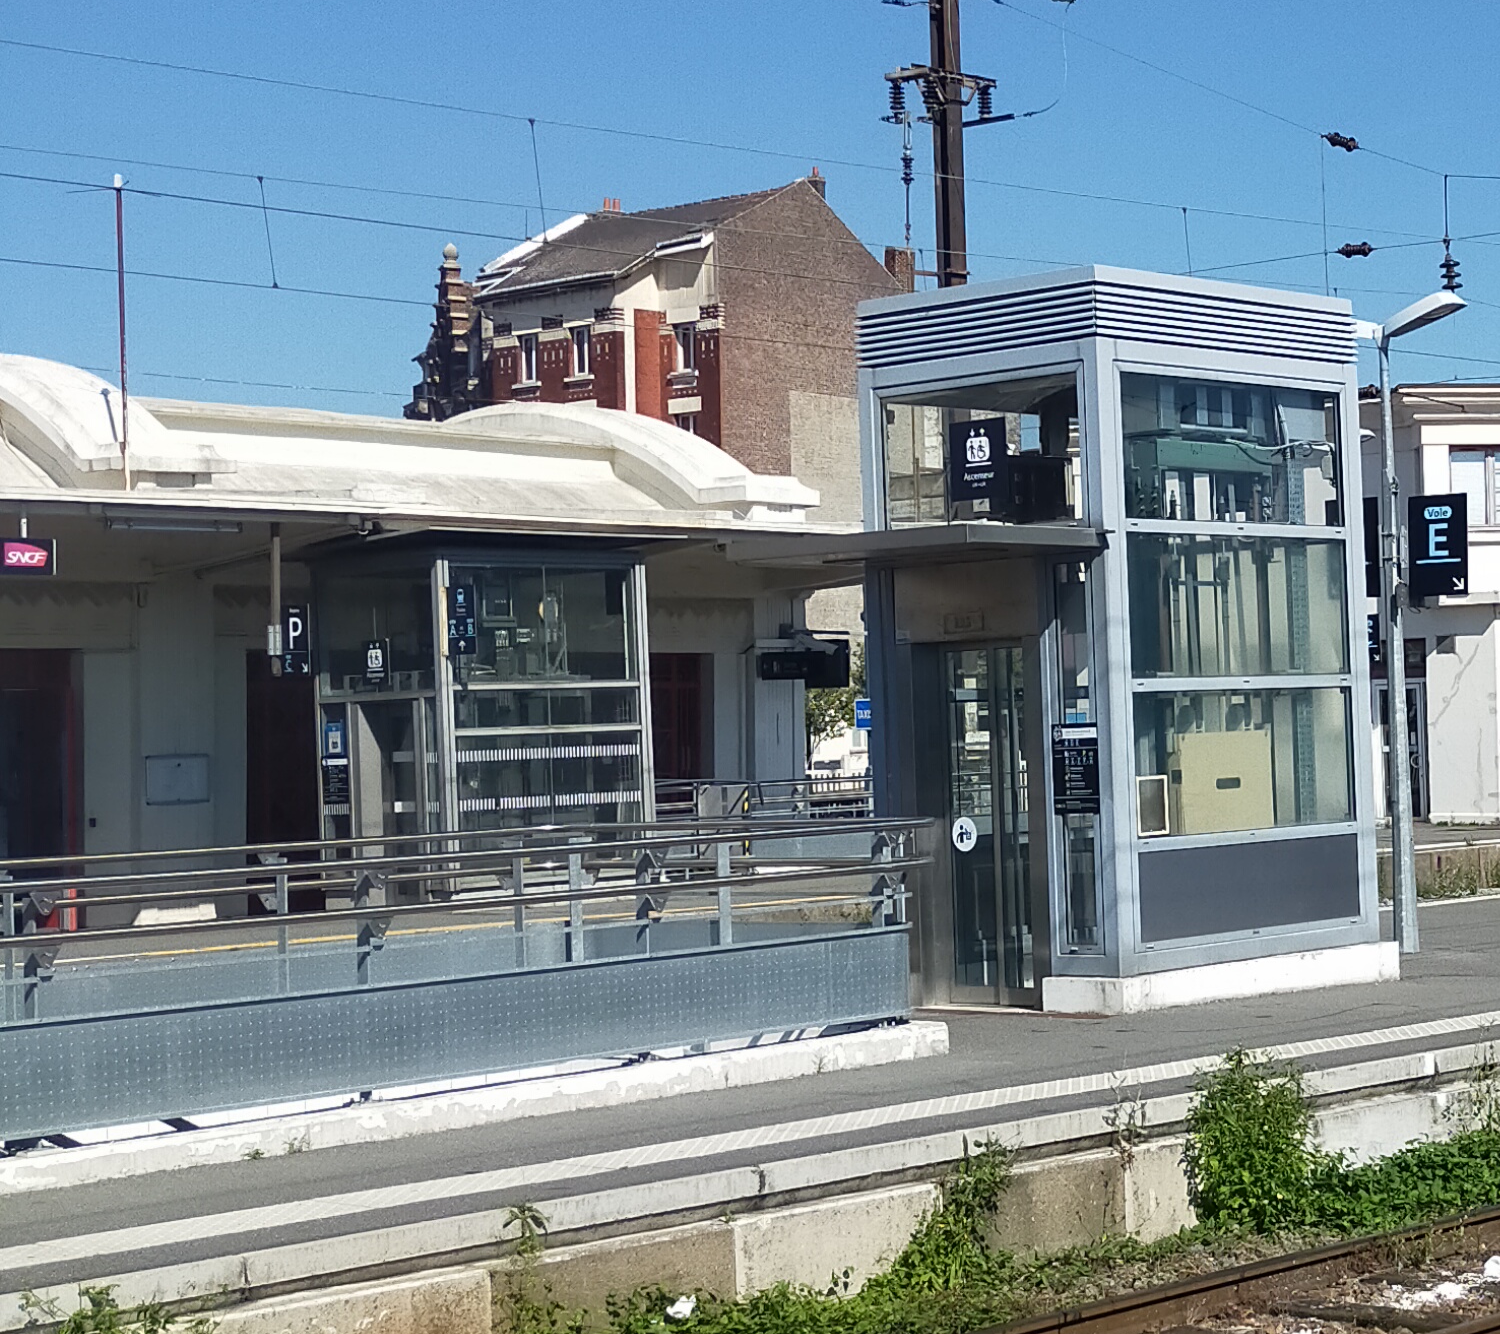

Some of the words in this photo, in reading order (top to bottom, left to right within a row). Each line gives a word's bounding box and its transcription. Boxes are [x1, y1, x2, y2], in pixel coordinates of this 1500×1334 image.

[1429, 523, 1449, 557] E
[6, 551, 45, 564] SNCF
[289, 617, 302, 649] P
